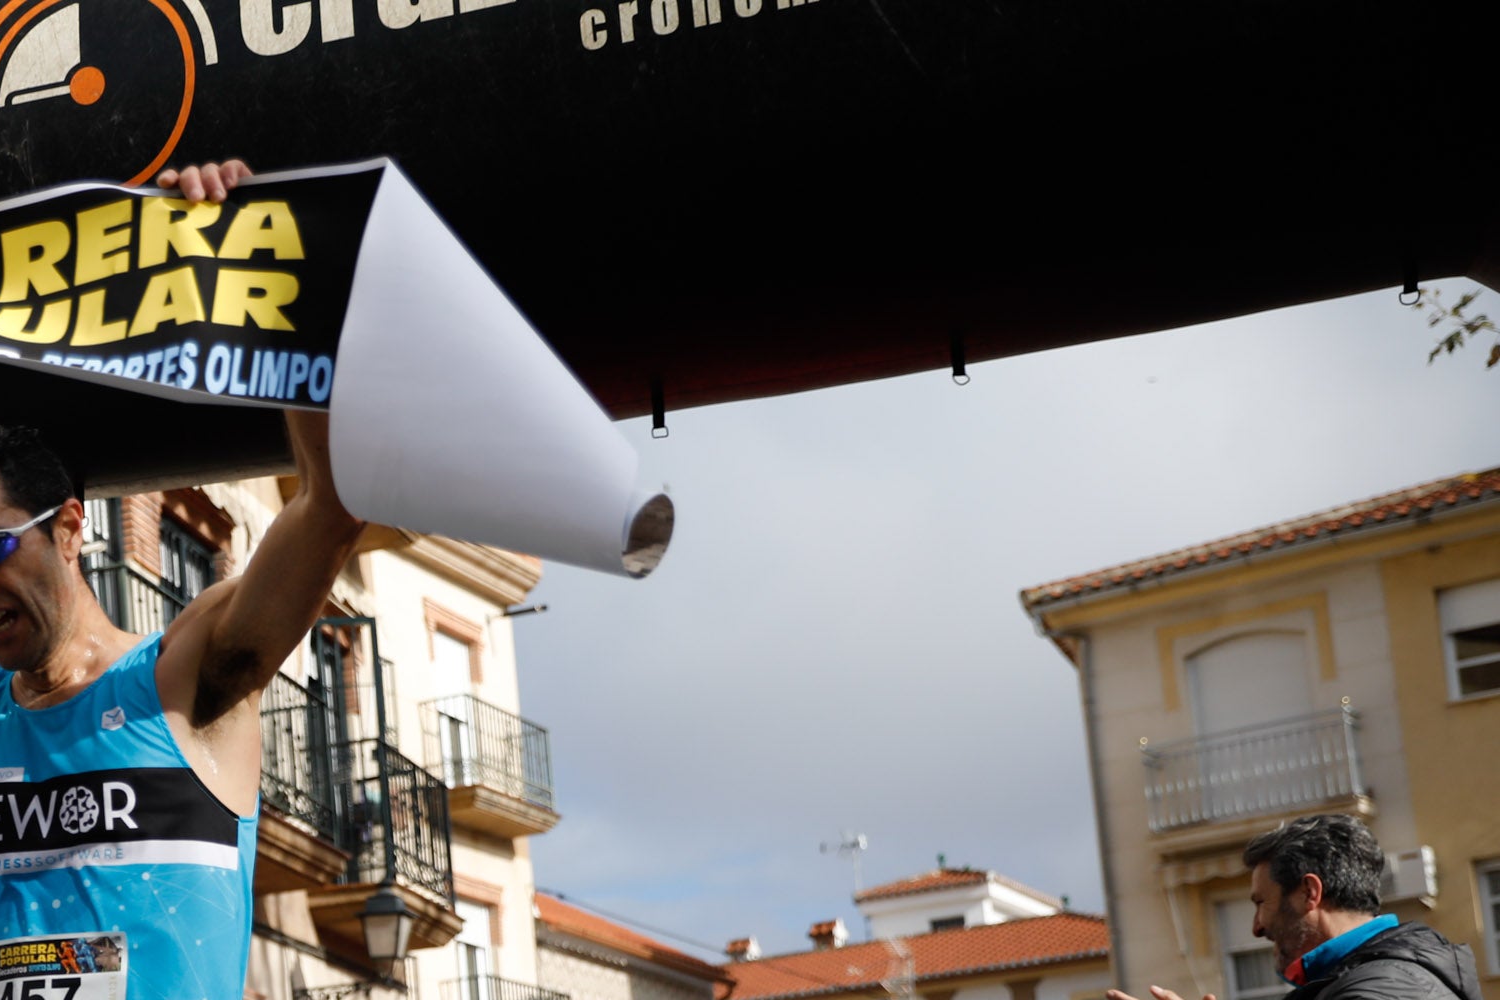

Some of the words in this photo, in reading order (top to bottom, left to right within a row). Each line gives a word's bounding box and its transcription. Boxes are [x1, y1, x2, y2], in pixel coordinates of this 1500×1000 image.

[579, 0, 821, 50] cron
[204, 345, 334, 402] OLIMPO
[0, 943, 57, 959] CARRERA
[0, 954, 57, 968] POPULAR
